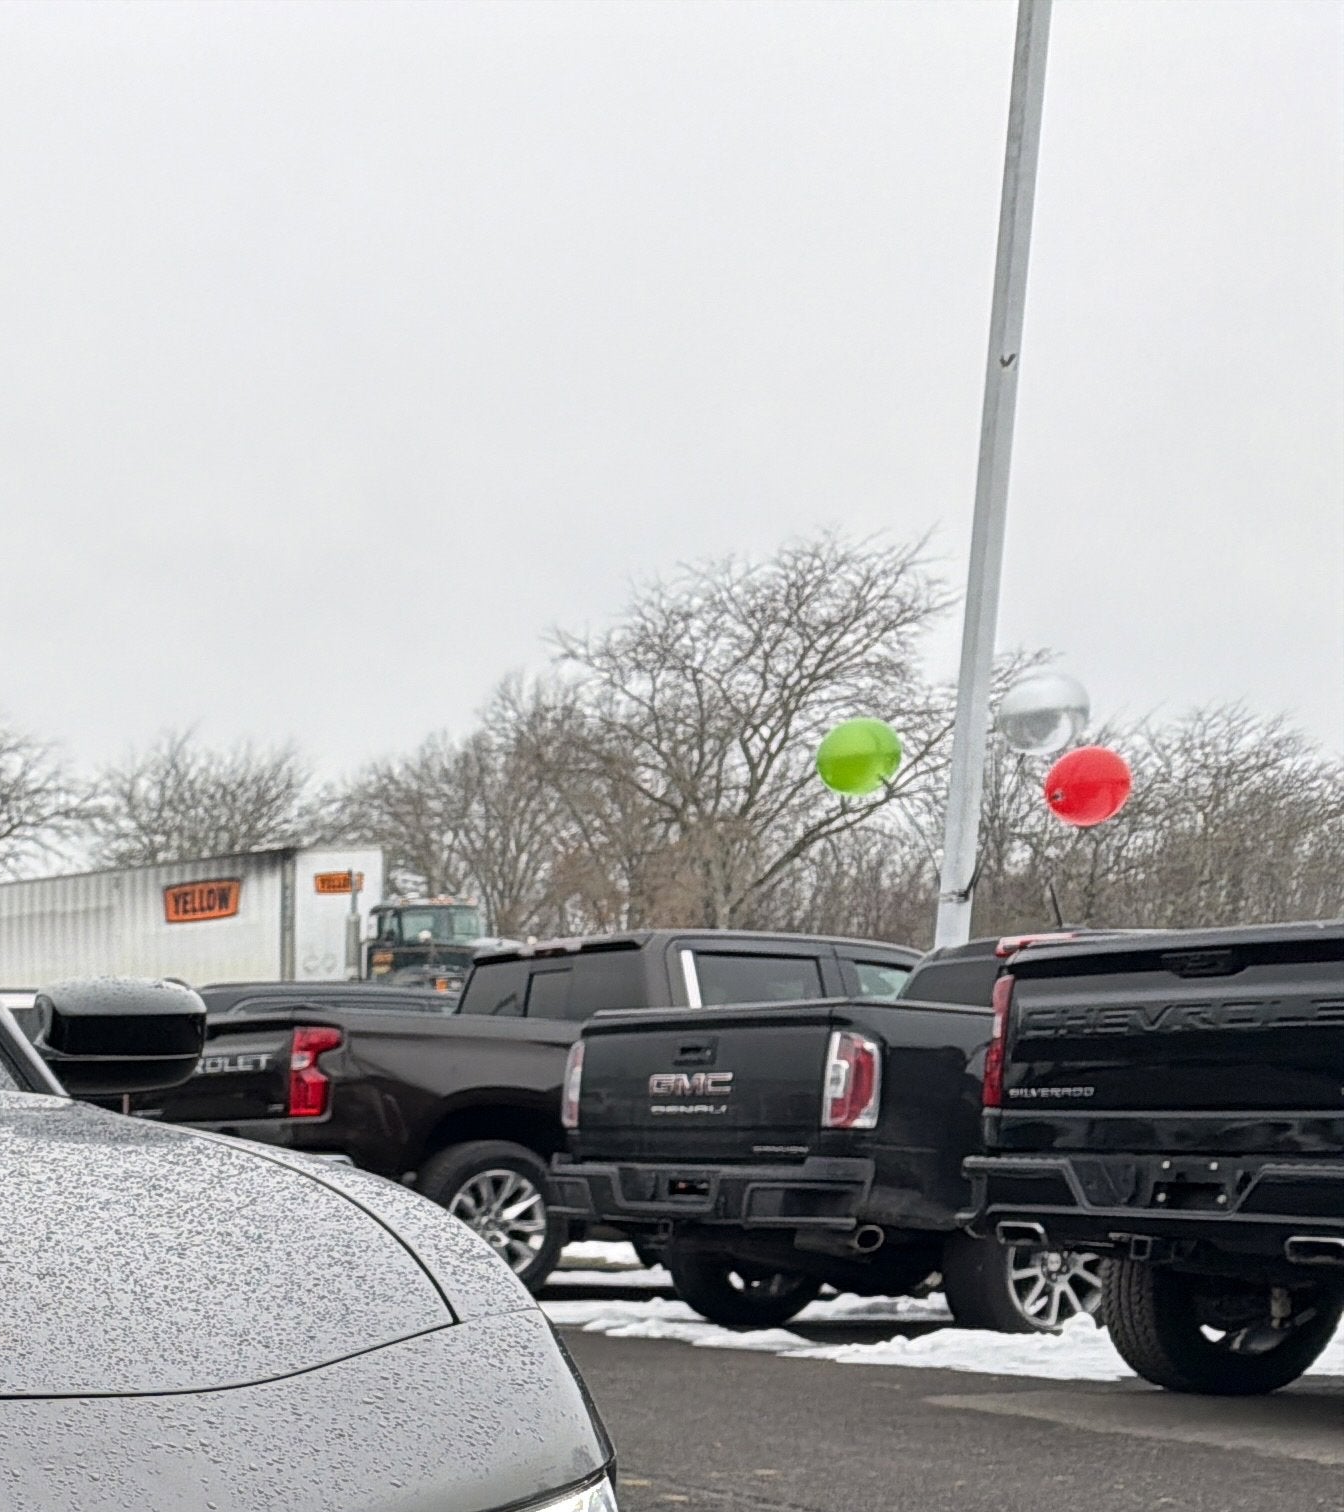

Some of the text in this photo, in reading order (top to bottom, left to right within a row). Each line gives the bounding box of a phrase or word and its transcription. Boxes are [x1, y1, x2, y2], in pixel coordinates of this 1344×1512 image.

[175, 887, 231, 915] YELLOW
[649, 1072, 733, 1096] GMC
[1009, 1087, 1094, 1098] SILVERADO
